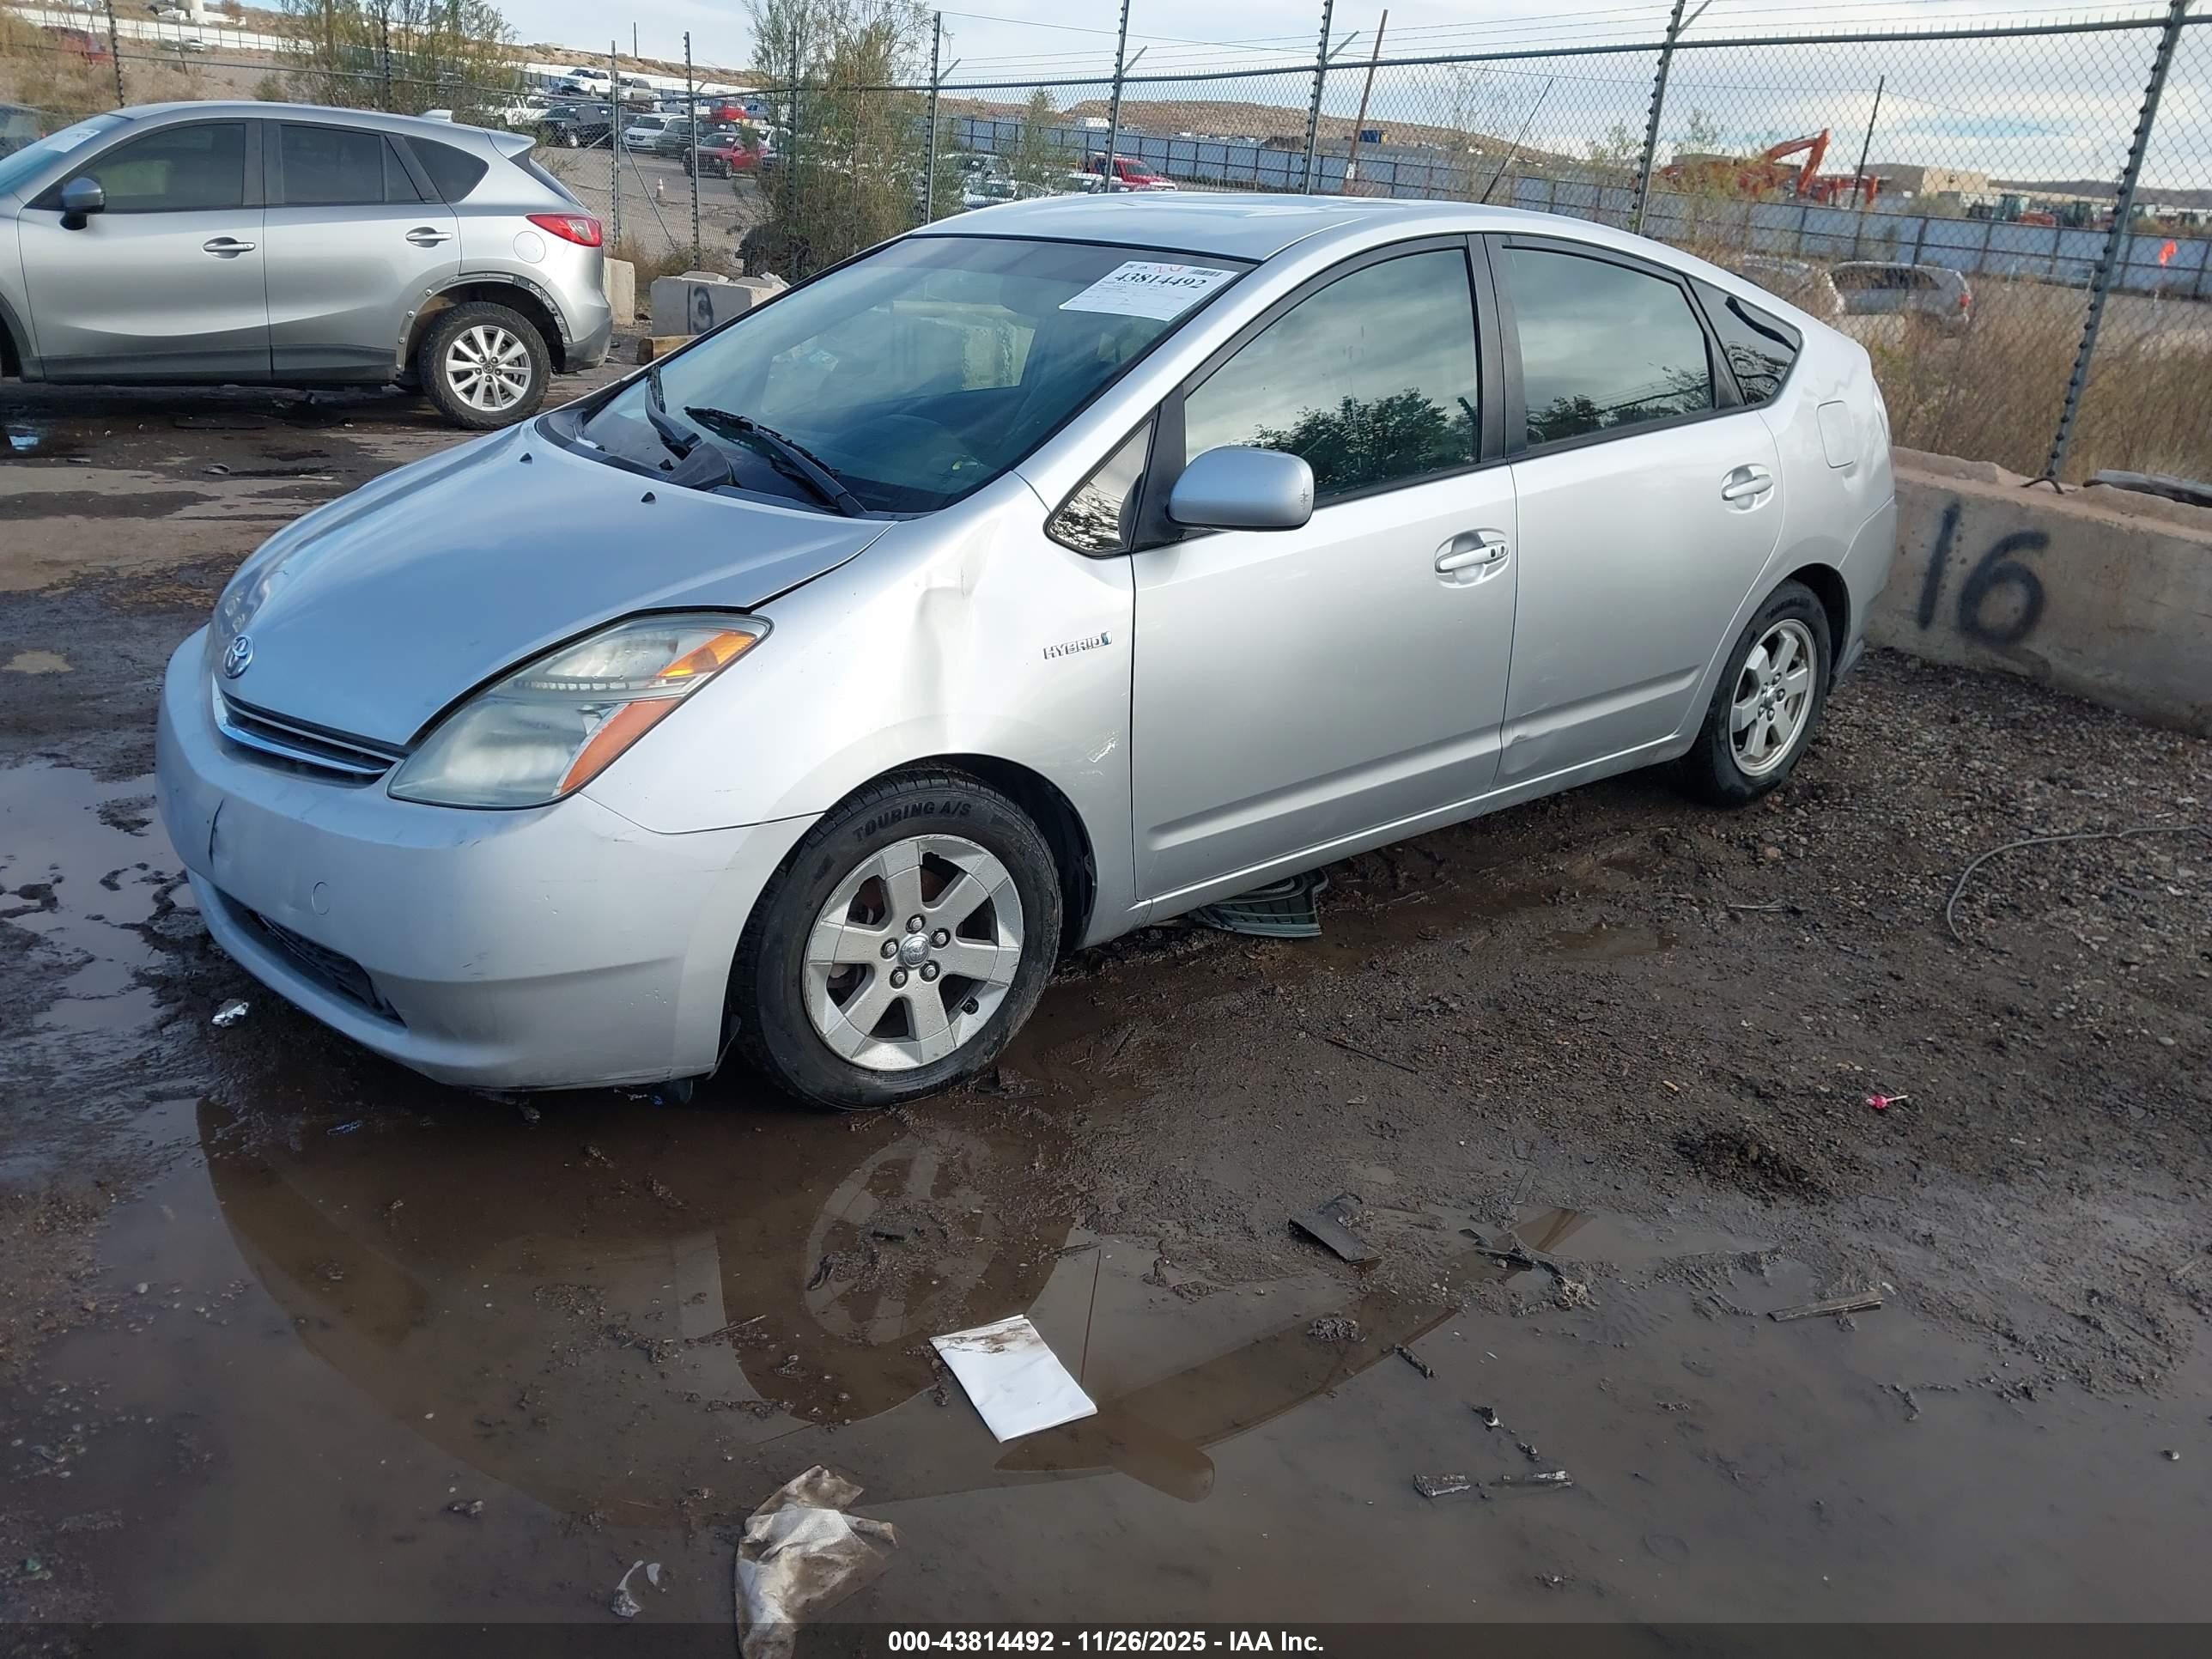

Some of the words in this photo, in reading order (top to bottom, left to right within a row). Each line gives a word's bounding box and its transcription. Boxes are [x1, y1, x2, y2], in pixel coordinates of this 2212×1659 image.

[1115, 272, 1207, 289] 43814492
[1917, 497, 2050, 647] 16
[1042, 635, 1100, 659] HYBRID
[853, 801, 935, 842] TOURING
[939, 800, 972, 817] A/S
